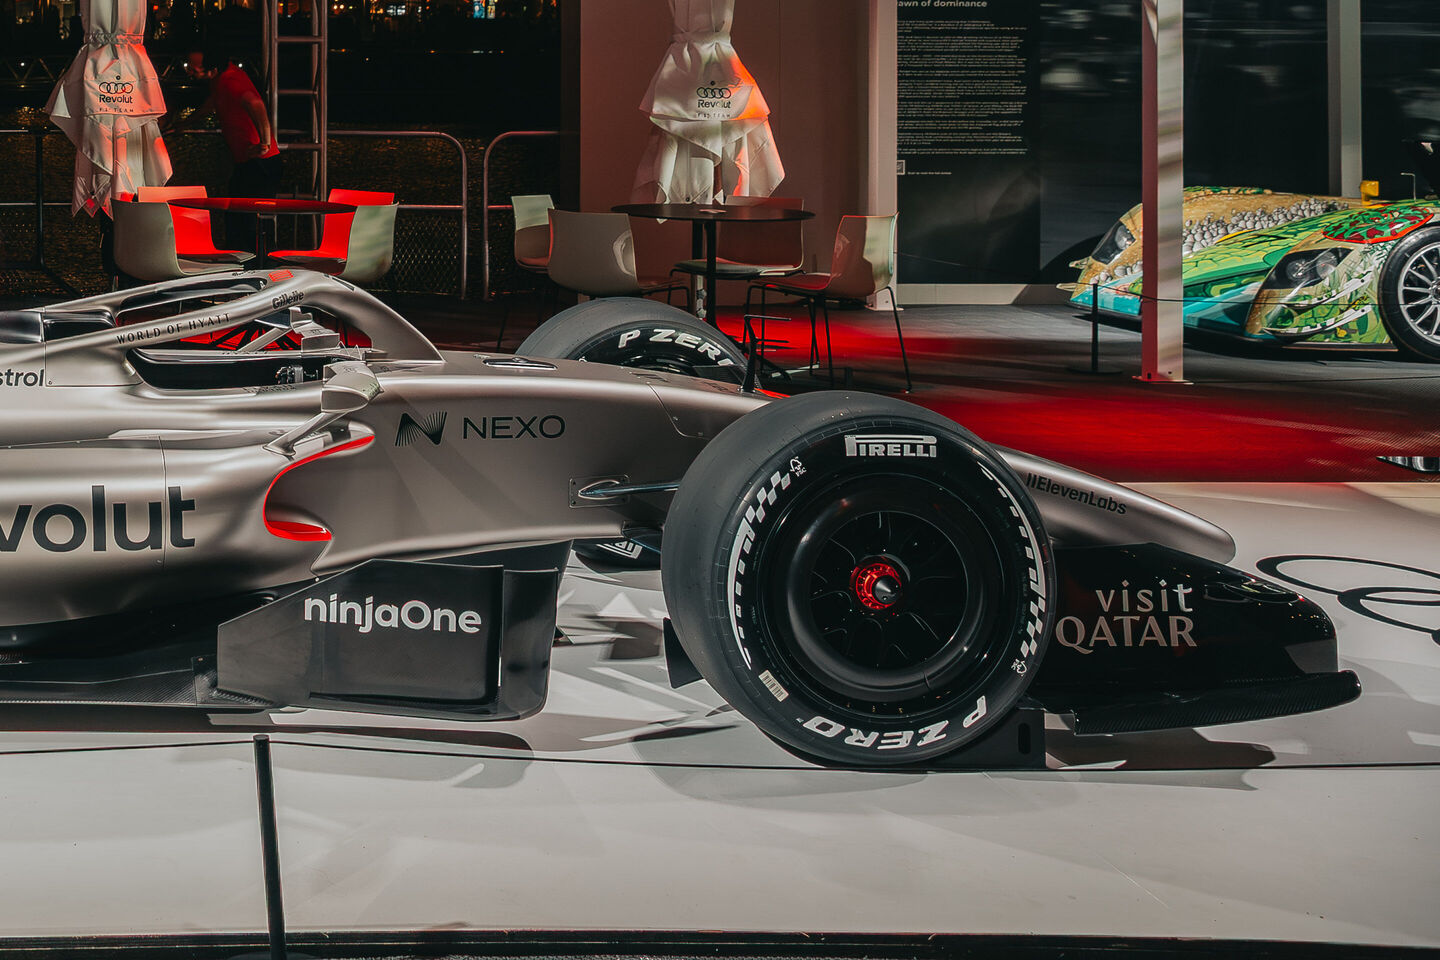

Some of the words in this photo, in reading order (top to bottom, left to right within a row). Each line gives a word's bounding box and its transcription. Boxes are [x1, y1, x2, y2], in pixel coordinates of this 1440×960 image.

[896, 0, 919, 8] awn
[921, 0, 932, 8] of
[933, 0, 988, 8] dominance
[99, 94, 133, 104] Revolut
[271, 290, 305, 310] Gillette
[116, 327, 161, 345] WORLD
[167, 322, 183, 334] OF
[189, 312, 231, 330] HYATT
[617, 329, 641, 349] P
[463, 414, 566, 440] NEXO
[844, 434, 938, 458] PIRELLI
[1096, 580, 1194, 613] visit
[304, 593, 482, 634] ninjaOne
[1055, 615, 1198, 655] QATAR
[962, 695, 987, 729] P
[802, 714, 950, 750] ZERO
